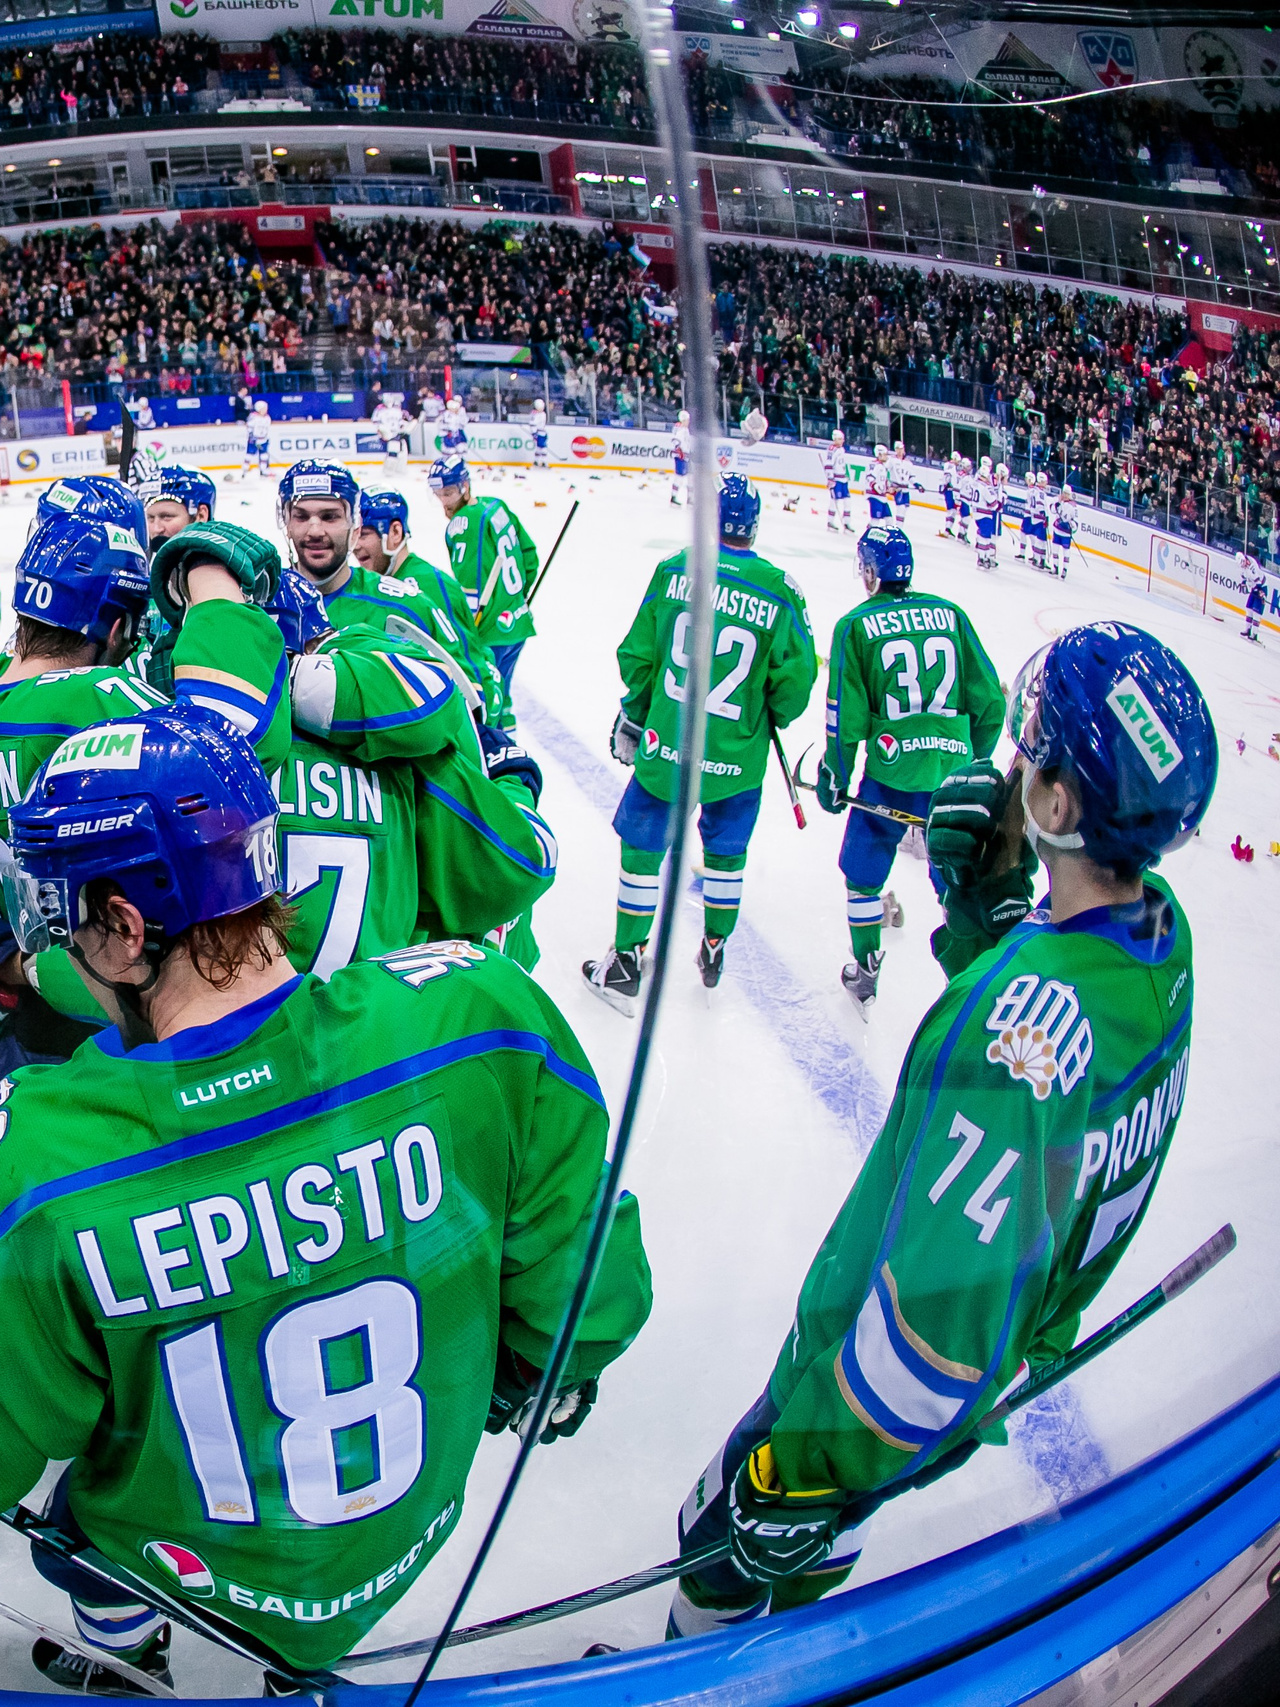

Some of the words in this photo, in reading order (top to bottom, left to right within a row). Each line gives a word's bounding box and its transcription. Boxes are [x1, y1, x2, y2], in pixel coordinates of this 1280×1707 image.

[476, 23, 523, 36] САЛАВАТ
[526, 27, 564, 38] ЮЛАЕВ
[892, 44, 956, 60] ШНЕФТЬ
[1204, 315, 1211, 329] 6
[1228, 320, 1236, 333] 7
[909, 405, 943, 418] САЛАВАТ
[944, 411, 975, 422] ЮЛАЕВ
[171, 442, 245, 455] БАШНЕФТЬ
[280, 438, 350, 451] СОГАЗ
[467, 437, 535, 450] МЕГАФО
[611, 442, 675, 459] MasterCar
[295, 477, 331, 488] СОГАЗ
[112, 532, 139, 550] ATU
[724, 521, 746, 536] 92
[1080, 523, 1128, 547] БАШНЕФТЬ
[895, 564, 912, 577] 32
[24, 576, 53, 609] 70
[117, 578, 148, 592] BAUER
[665, 574, 779, 631] ARZMASTSEV
[862, 607, 957, 640] NESTEROV
[663, 610, 757, 722] 92
[881, 635, 958, 721] 32
[1115, 693, 1175, 769] ATUM
[51, 733, 135, 768] ATUM
[902, 737, 969, 755] БАШНЕФТЬ
[660, 746, 743, 777] БАНЕФТЬ
[271, 758, 383, 824] LISIN
[57, 814, 134, 838] BAUER
[245, 815, 277, 883] 18
[283, 833, 370, 985] 7
[992, 904, 1028, 922] BAUER
[1168, 968, 1188, 1008] LUTCH
[181, 1064, 273, 1107] LUTCH
[928, 1111, 1020, 1245] 74
[76, 1123, 445, 1319] LEPISTO
[160, 1276, 426, 1527] 18
[229, 1498, 458, 1622] БАШНЕФТЬ
